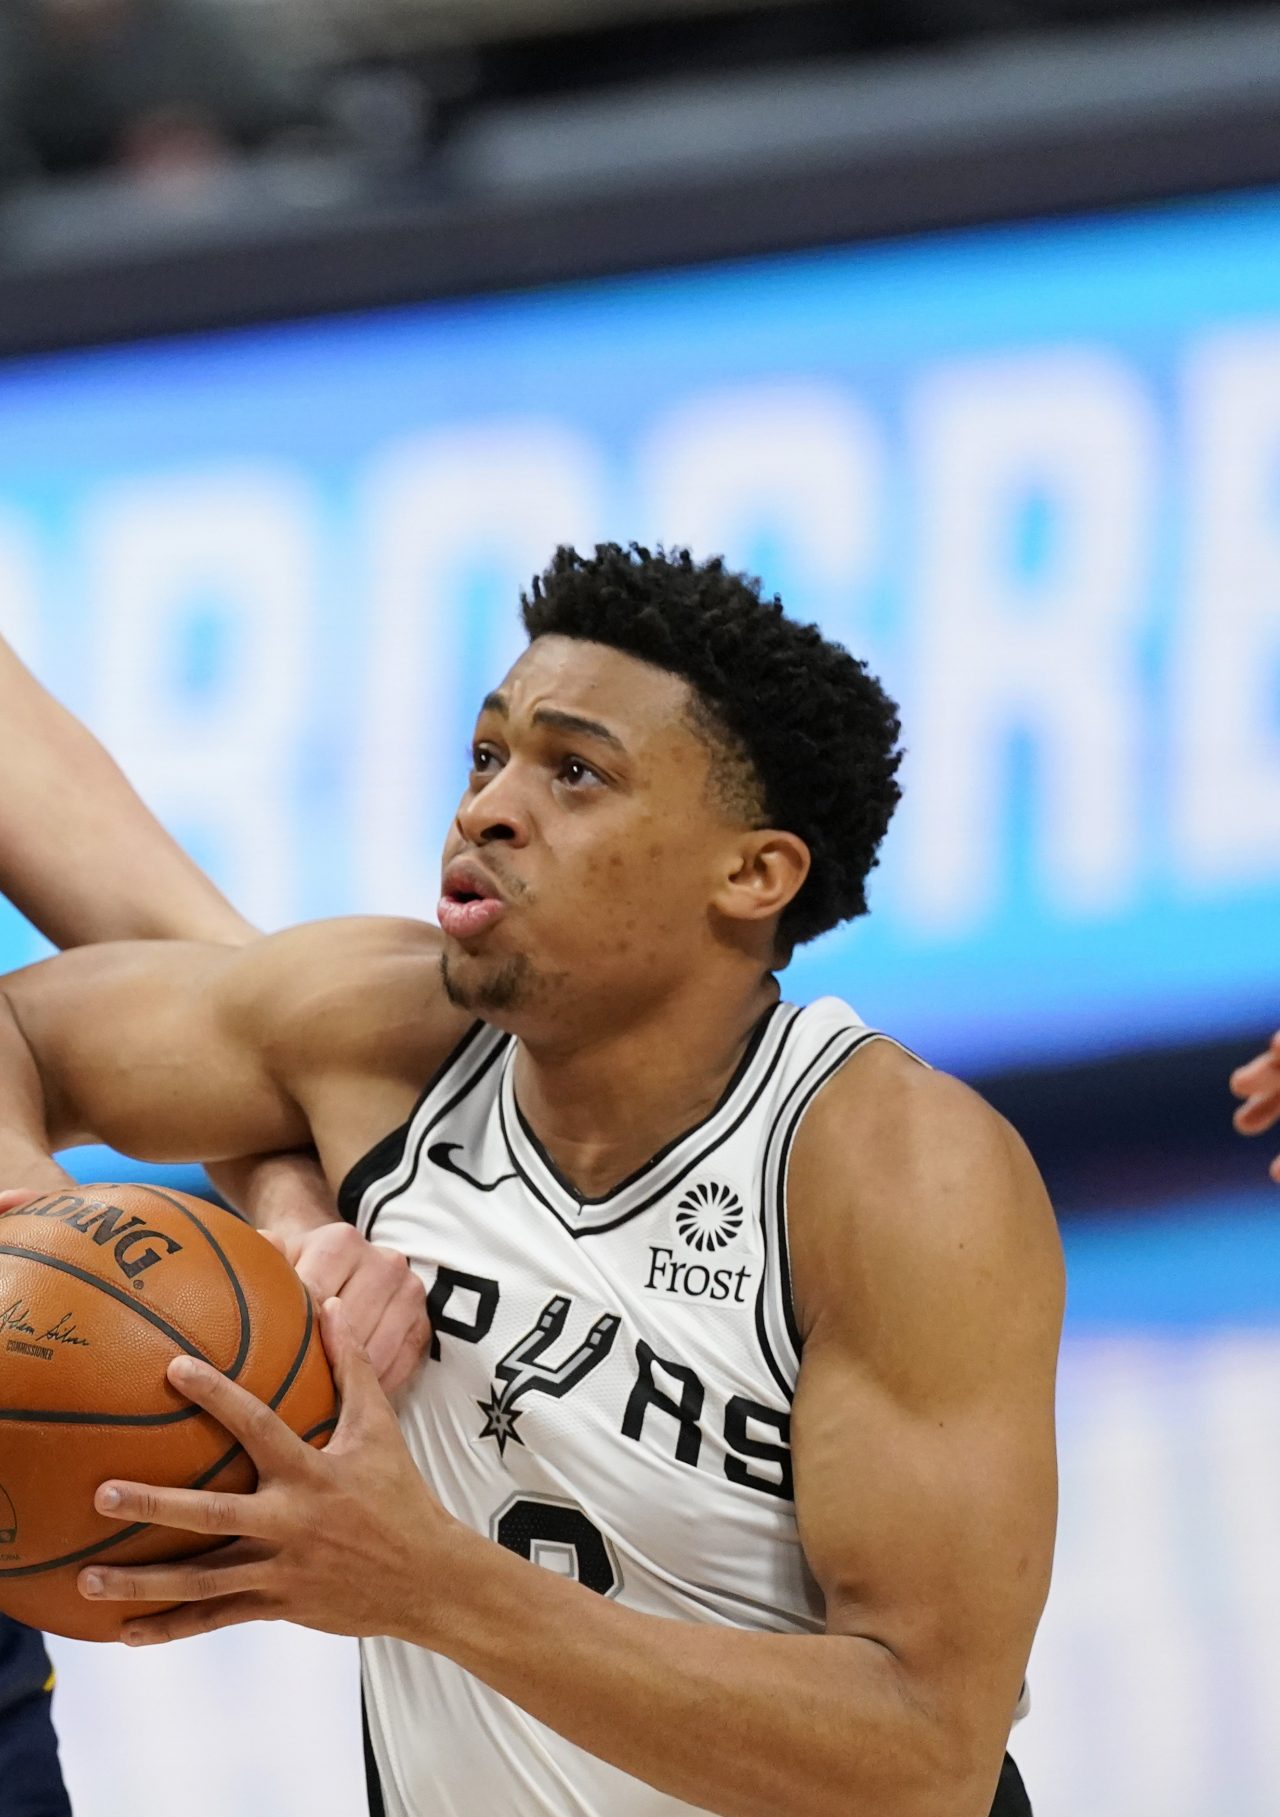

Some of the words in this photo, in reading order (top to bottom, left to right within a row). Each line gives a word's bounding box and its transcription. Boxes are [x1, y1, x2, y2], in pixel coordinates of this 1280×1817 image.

[1, 1194, 183, 1279] LDING
[645, 1245, 752, 1303] Frost
[6, 1339, 54, 1361] COMMISSIONER
[426, 1265, 795, 1502] PURS
